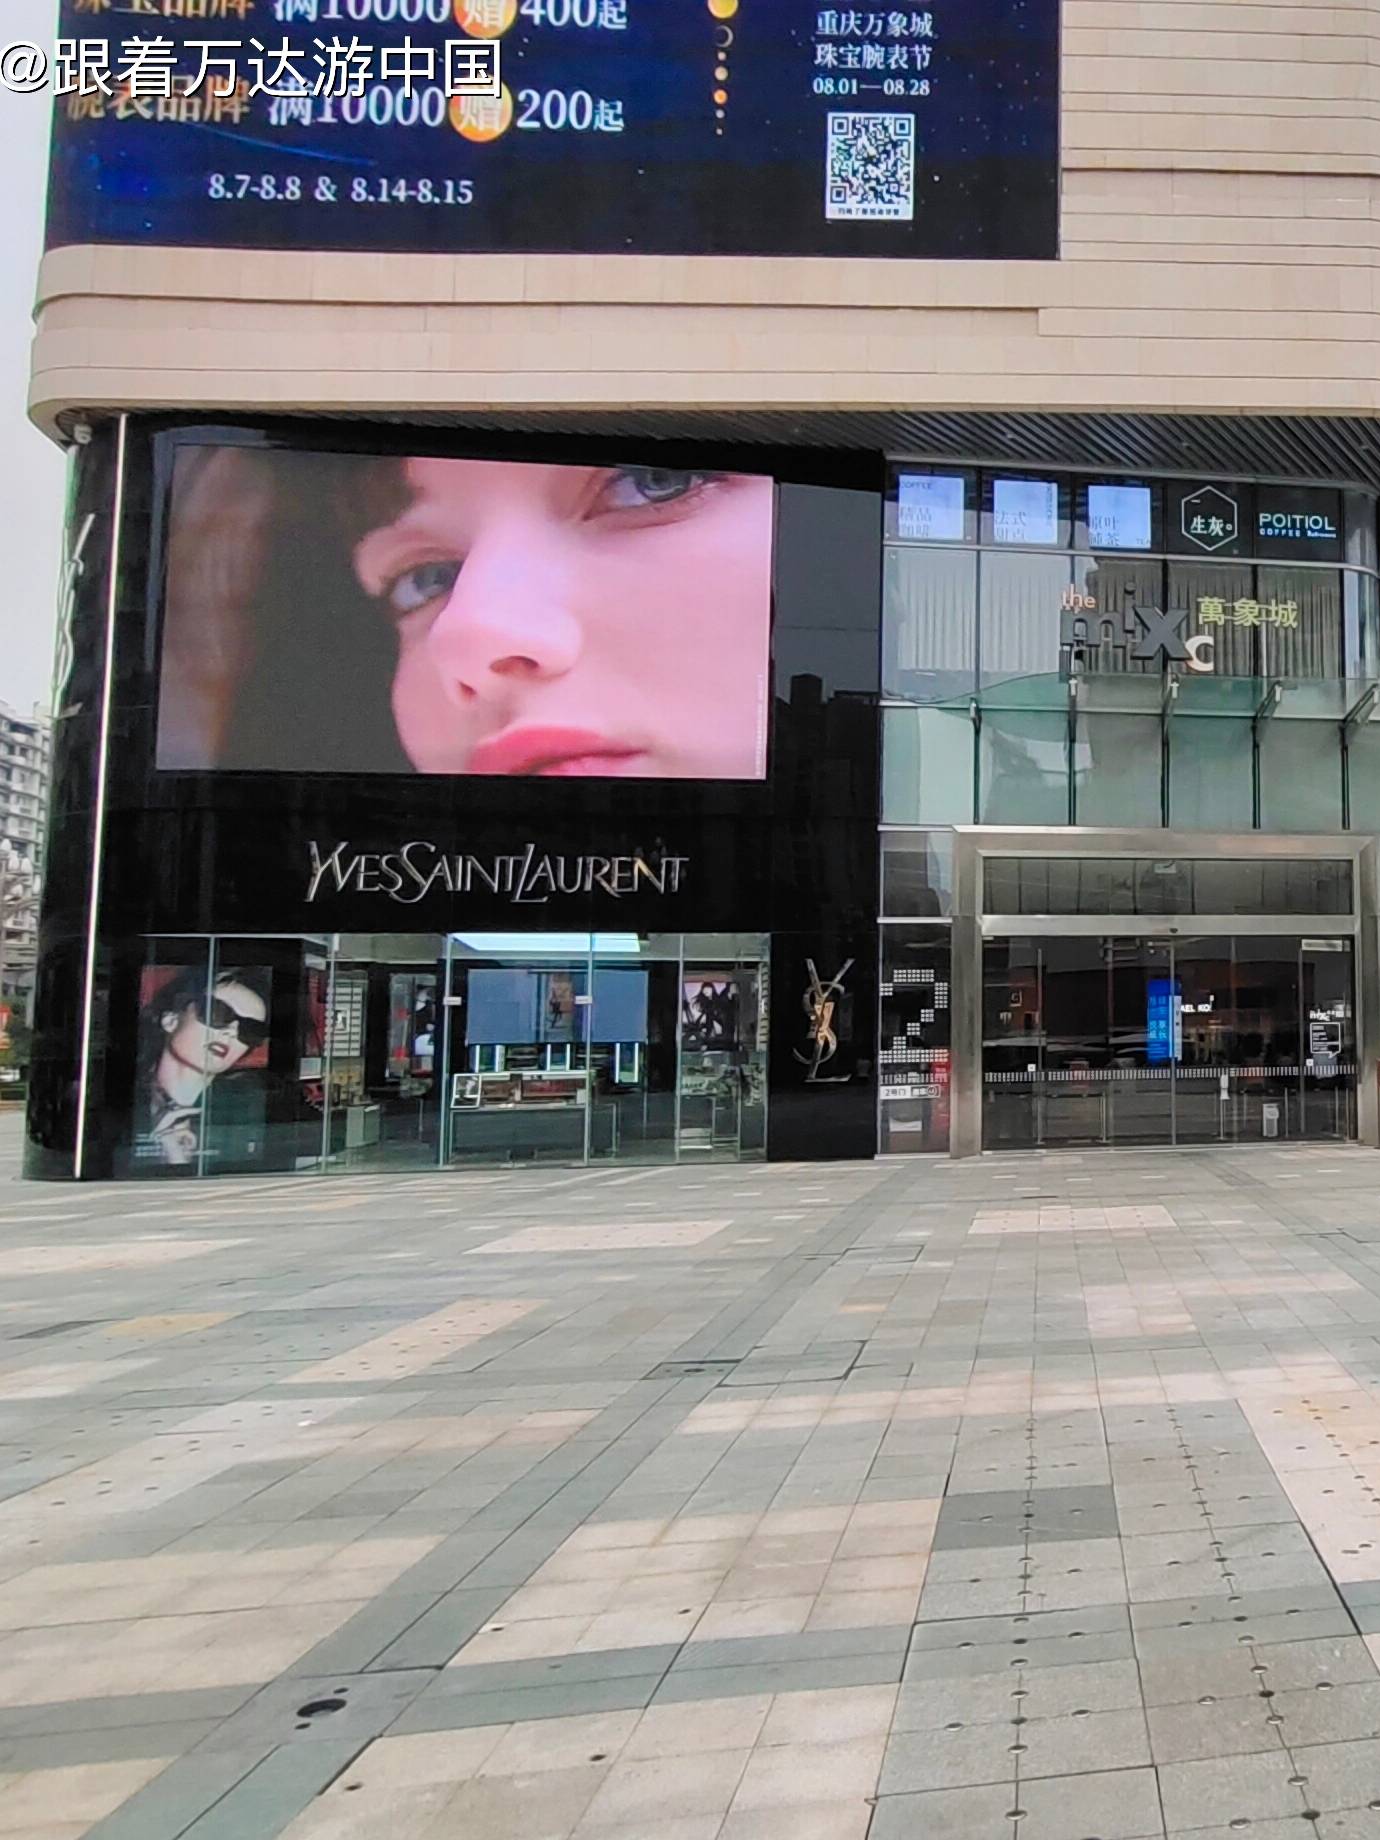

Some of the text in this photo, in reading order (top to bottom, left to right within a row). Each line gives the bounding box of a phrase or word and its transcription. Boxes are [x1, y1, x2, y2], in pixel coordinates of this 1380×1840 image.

[815, 10, 933, 36] 重庆万象城
[813, 44, 933, 70] 珠宝腕表节
[208, 174, 473, 204] 8.7-8.8 & 8.14-8.15
[1259, 513, 1337, 531] POITIOL
[1259, 528, 1301, 538] COFFEE
[1061, 584, 1097, 610] the
[1198, 597, 1298, 629] 萬象城
